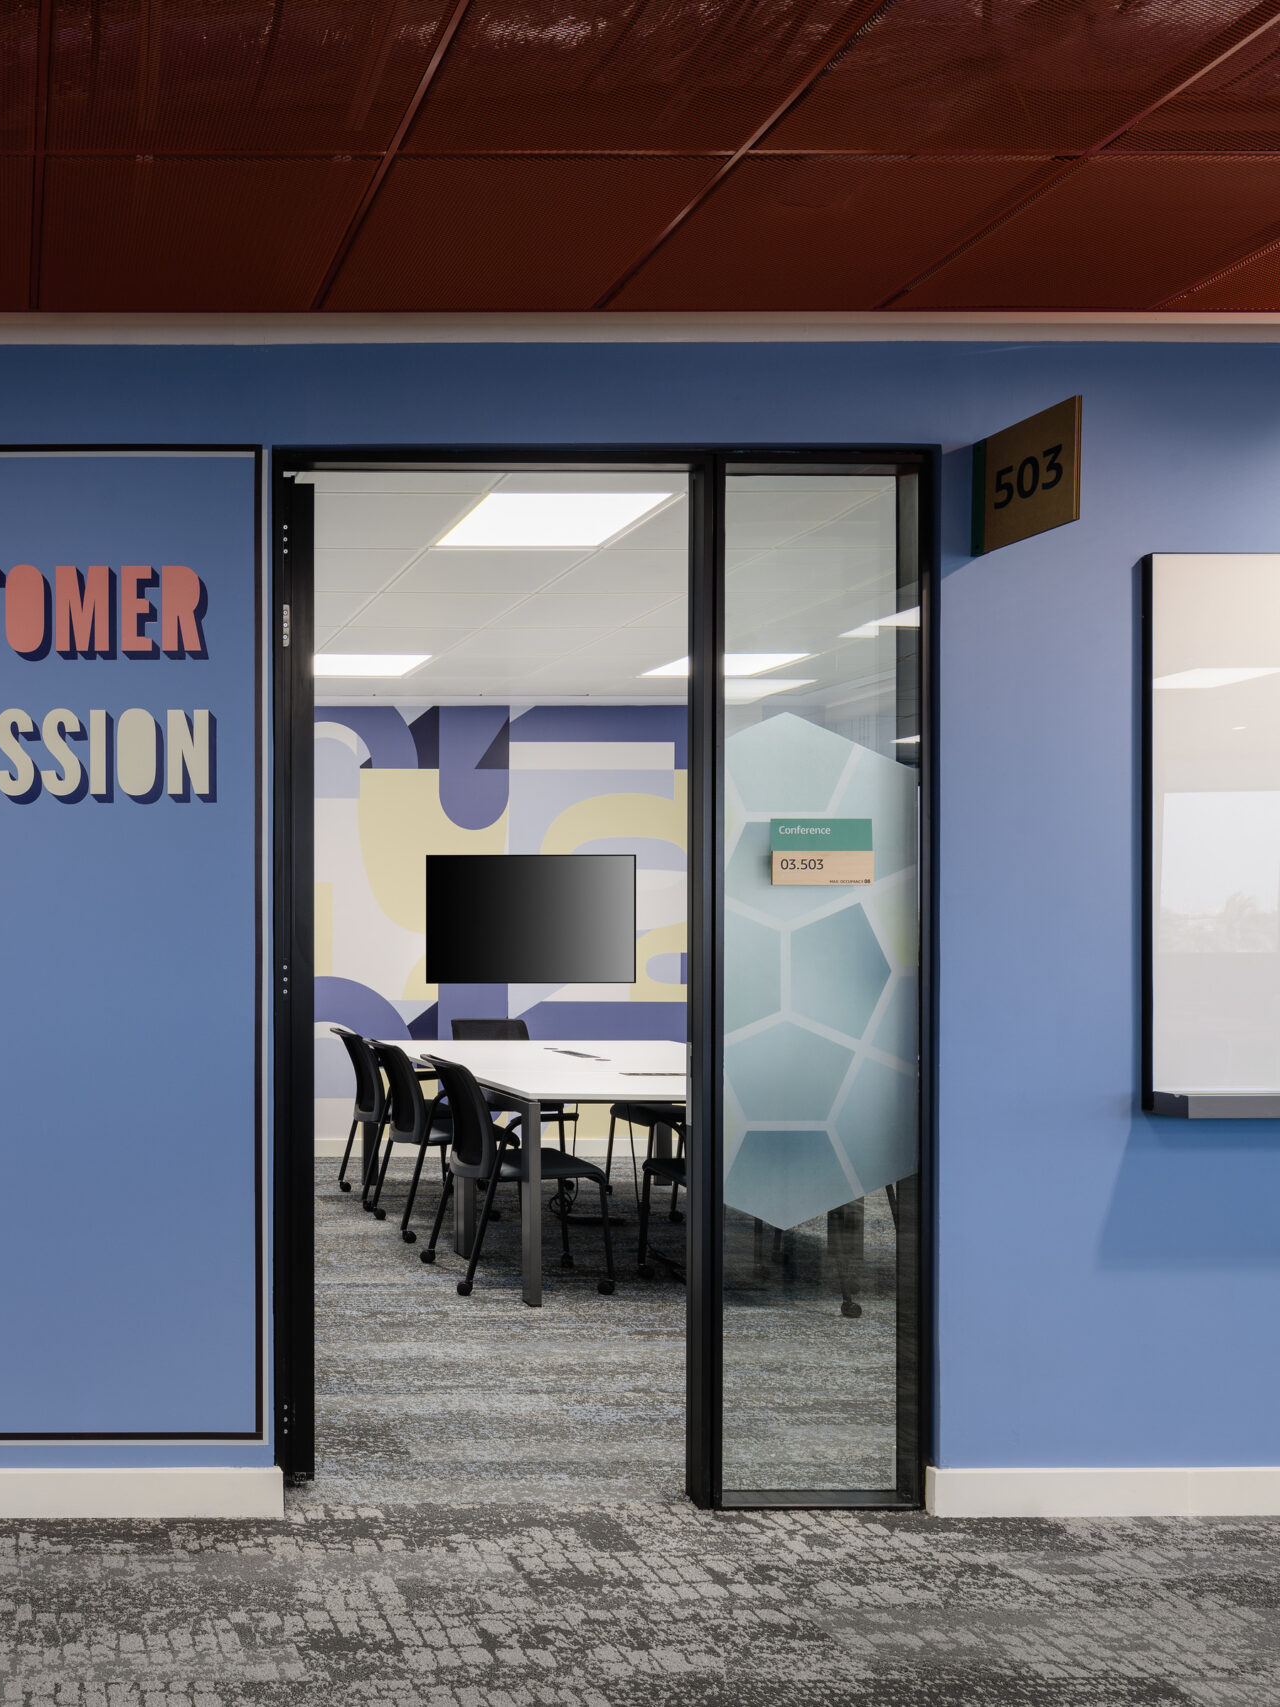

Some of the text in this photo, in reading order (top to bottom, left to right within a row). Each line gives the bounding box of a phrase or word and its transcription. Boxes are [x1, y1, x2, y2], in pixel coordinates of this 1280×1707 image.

[993, 443, 1063, 510] 503
[778, 825, 831, 835] Conference
[780, 858, 824, 870] 03.503
